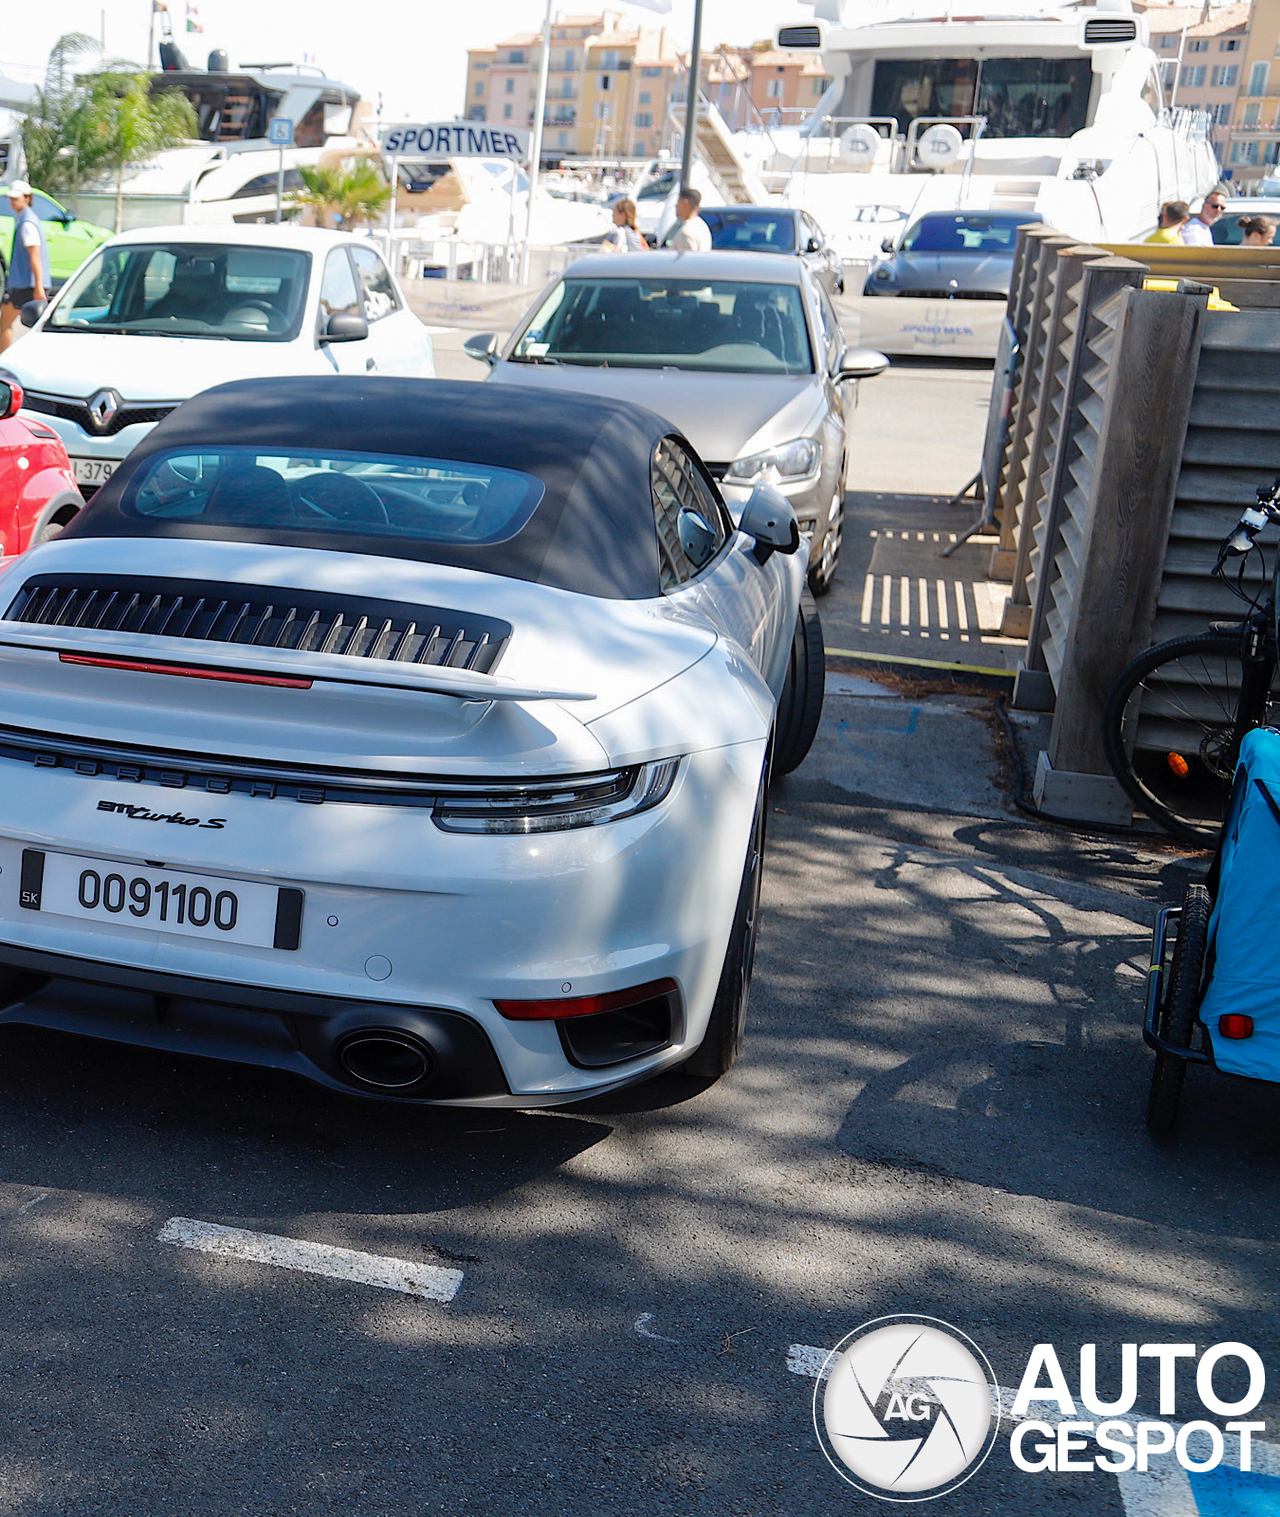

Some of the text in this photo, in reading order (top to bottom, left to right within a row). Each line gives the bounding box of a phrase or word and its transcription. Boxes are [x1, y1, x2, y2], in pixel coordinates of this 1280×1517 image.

[385, 127, 523, 154] SPORTMER
[34, 754, 326, 805] PORSCHE
[199, 818, 227, 829] S
[22, 891, 38, 905] SK
[78, 869, 238, 931] 0091100
